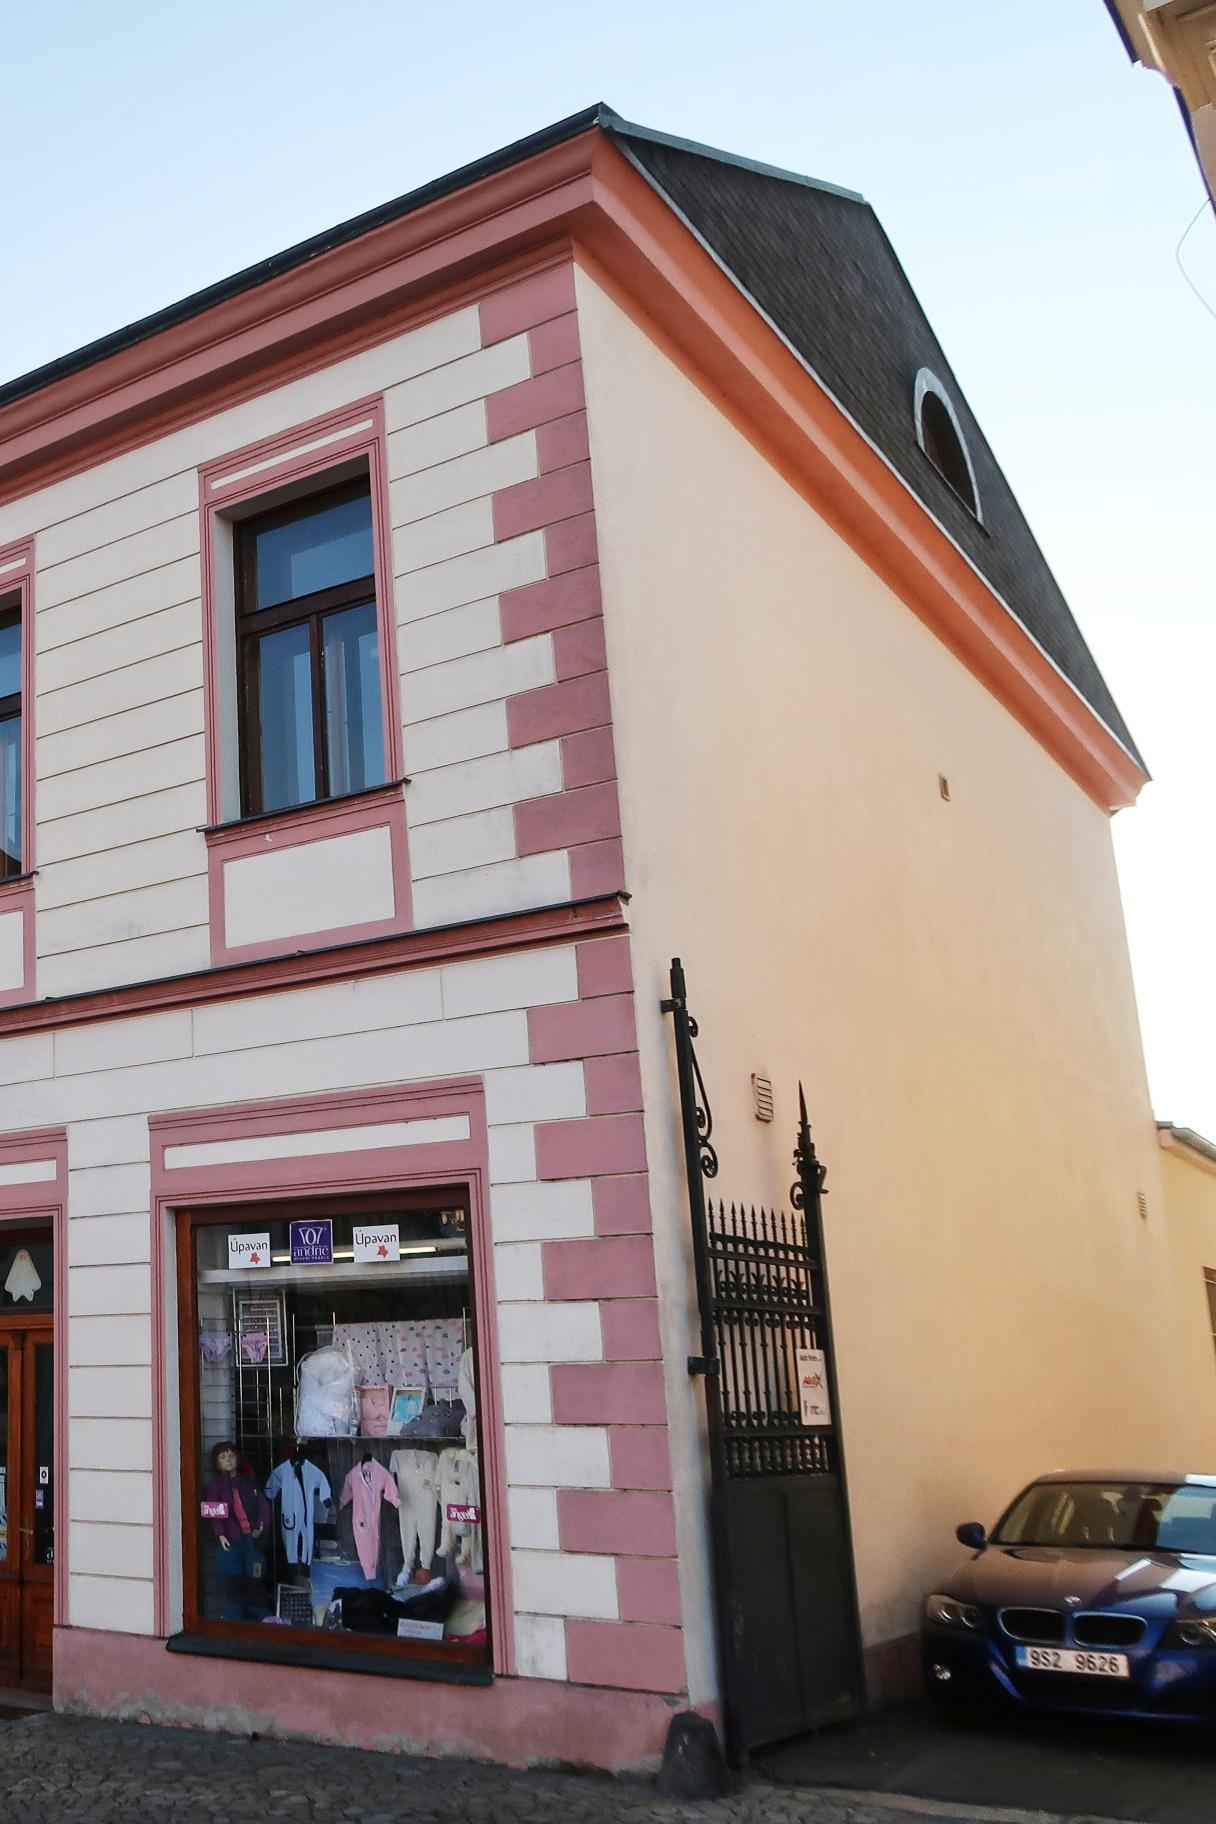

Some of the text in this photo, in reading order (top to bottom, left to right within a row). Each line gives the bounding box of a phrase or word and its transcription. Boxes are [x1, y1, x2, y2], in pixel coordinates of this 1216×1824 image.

[230, 1237, 268, 1252] Úpavan
[356, 1230, 397, 1246] Úpavan
[1030, 1649, 1121, 1674] 9S2 9626
